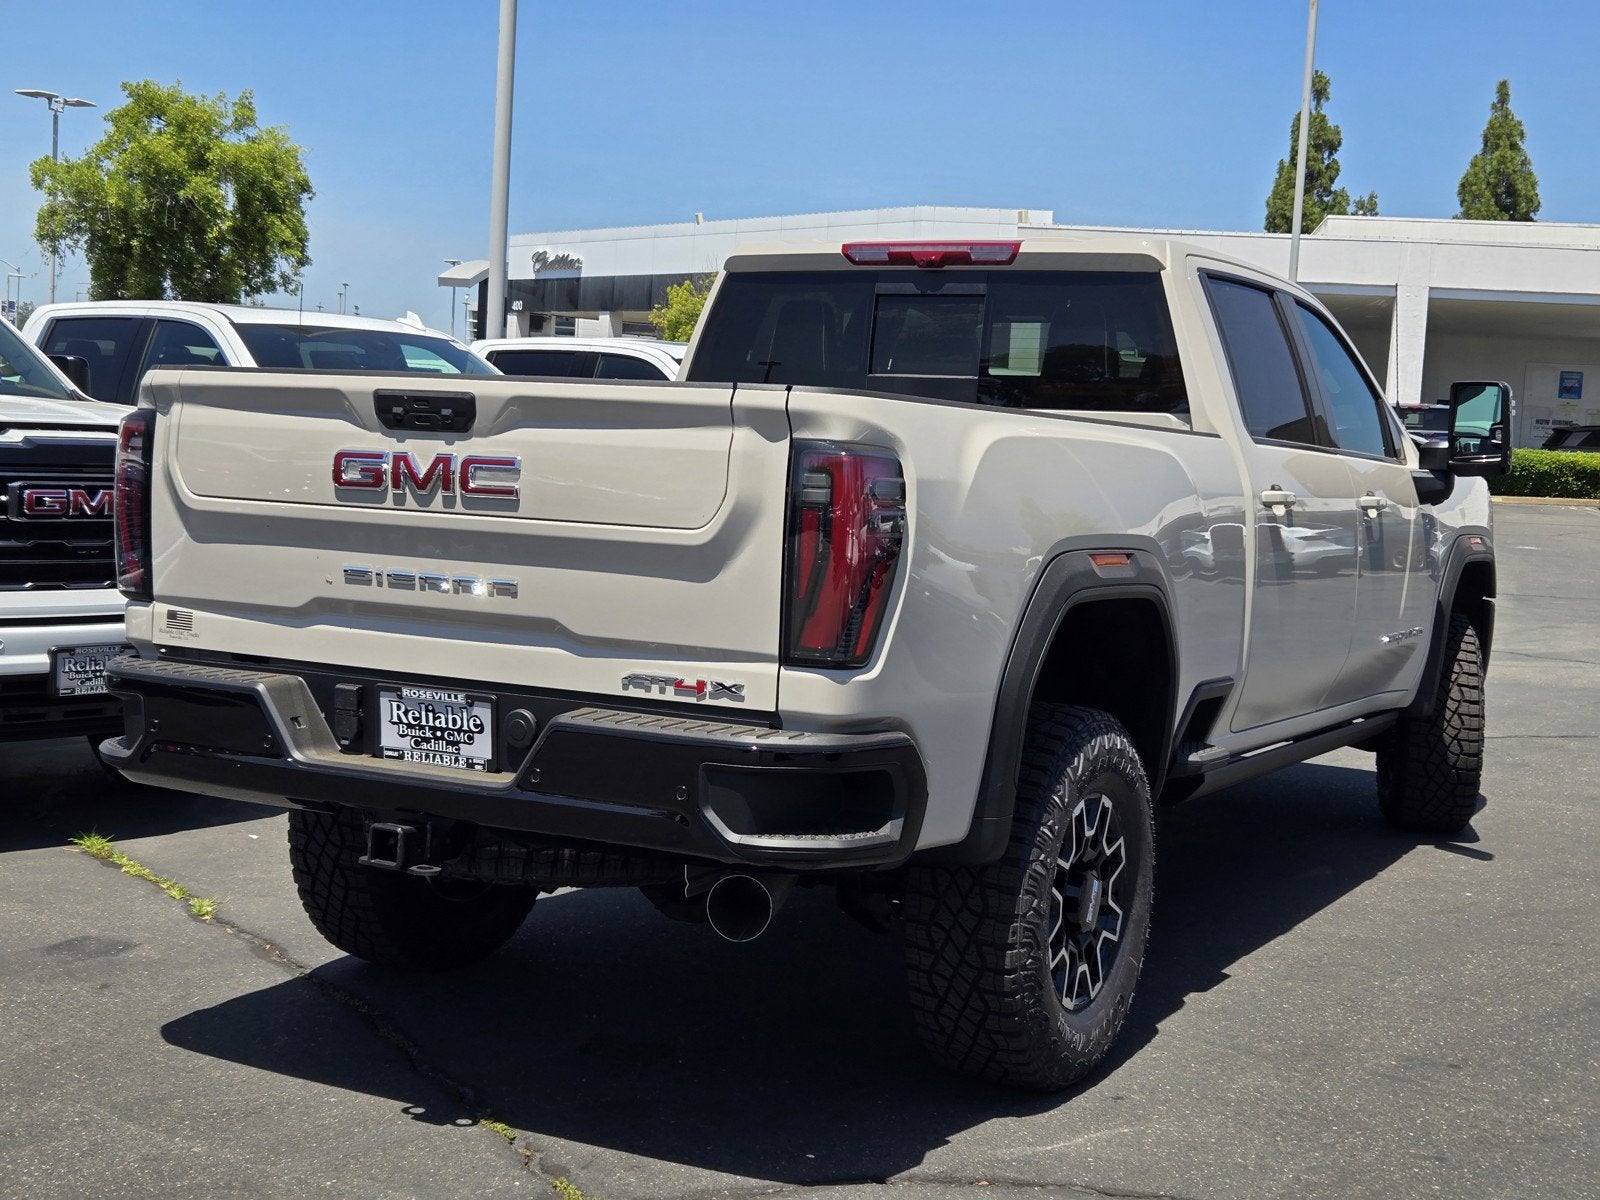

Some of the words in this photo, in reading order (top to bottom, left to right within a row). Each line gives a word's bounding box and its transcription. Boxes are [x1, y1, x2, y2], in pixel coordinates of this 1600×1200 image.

[532, 250, 583, 272] Cadillac
[512, 300, 523, 311] 400
[332, 449, 522, 501] GMC
[24, 488, 114, 515] GM
[343, 565, 519, 599] SIERRA
[63, 655, 110, 672] Relia
[69, 671, 95, 679] Buick
[78, 678, 105, 686] Cadill
[622, 673, 745, 698] AT4X
[402, 688, 466, 702] ROSEVILLE
[390, 701, 482, 732] Reliable
[399, 724, 434, 738] Buick
[444, 730, 474, 744] GMC
[411, 737, 459, 754] Cadillac
[404, 751, 467, 768] RELIABLE
